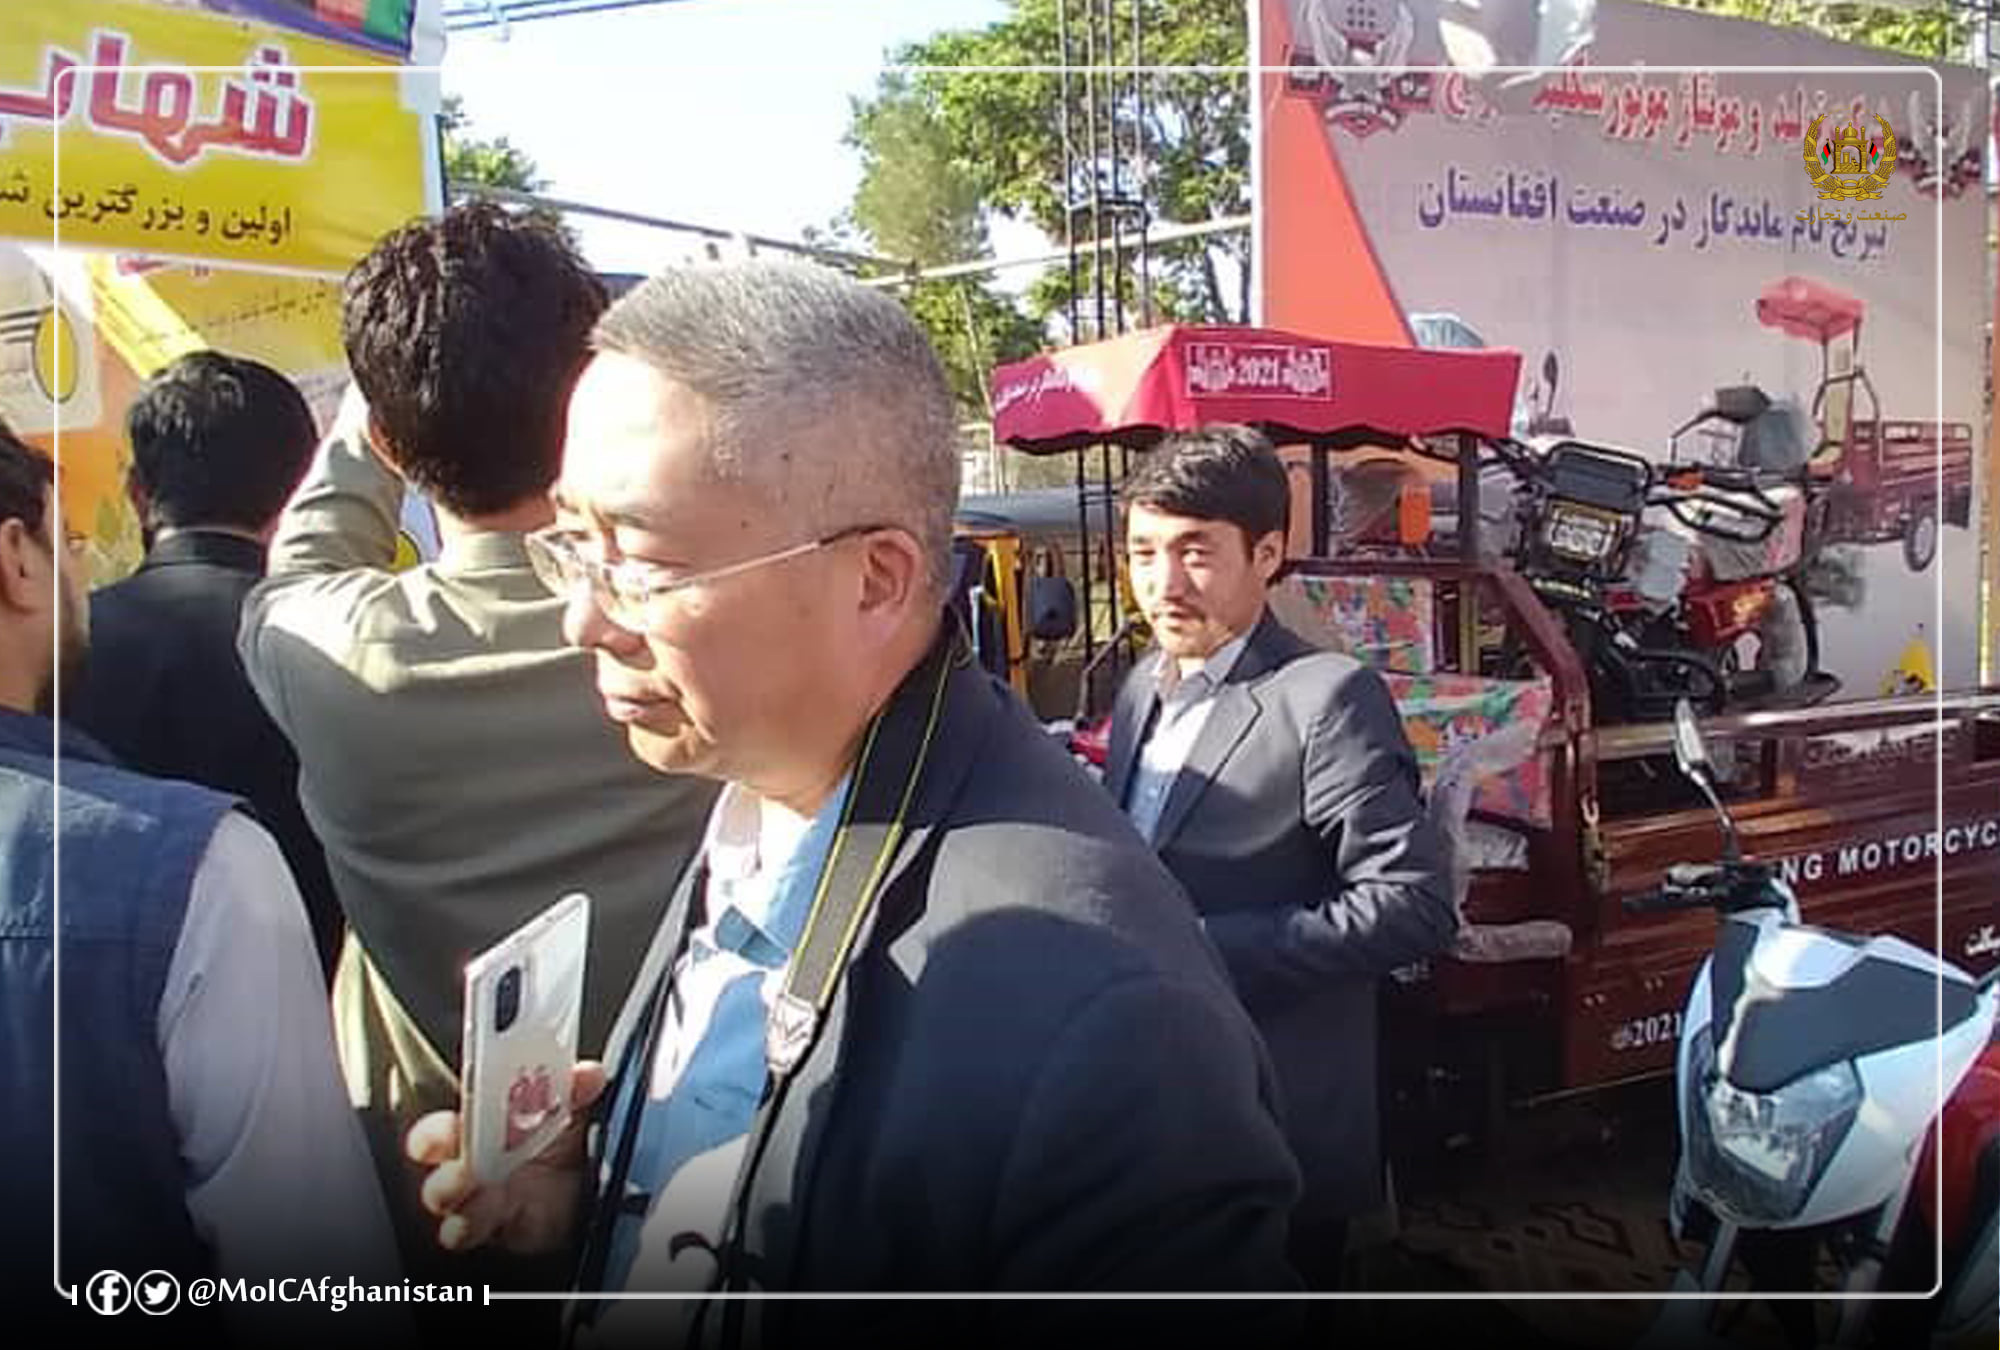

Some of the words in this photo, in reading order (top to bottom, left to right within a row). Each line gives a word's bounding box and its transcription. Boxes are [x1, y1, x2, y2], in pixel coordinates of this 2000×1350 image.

[1418, 166, 1557, 229] افغانستان
[1567, 187, 1647, 227] صنعت
[197, 209, 209, 236] و
[222, 205, 291, 245] اولین
[1656, 198, 1686, 245] در
[1236, 355, 1278, 388] 2021
[1779, 853, 1823, 884] NG
[1837, 819, 2000, 875] MOTORCYC
[1632, 1012, 1681, 1047] 2021
